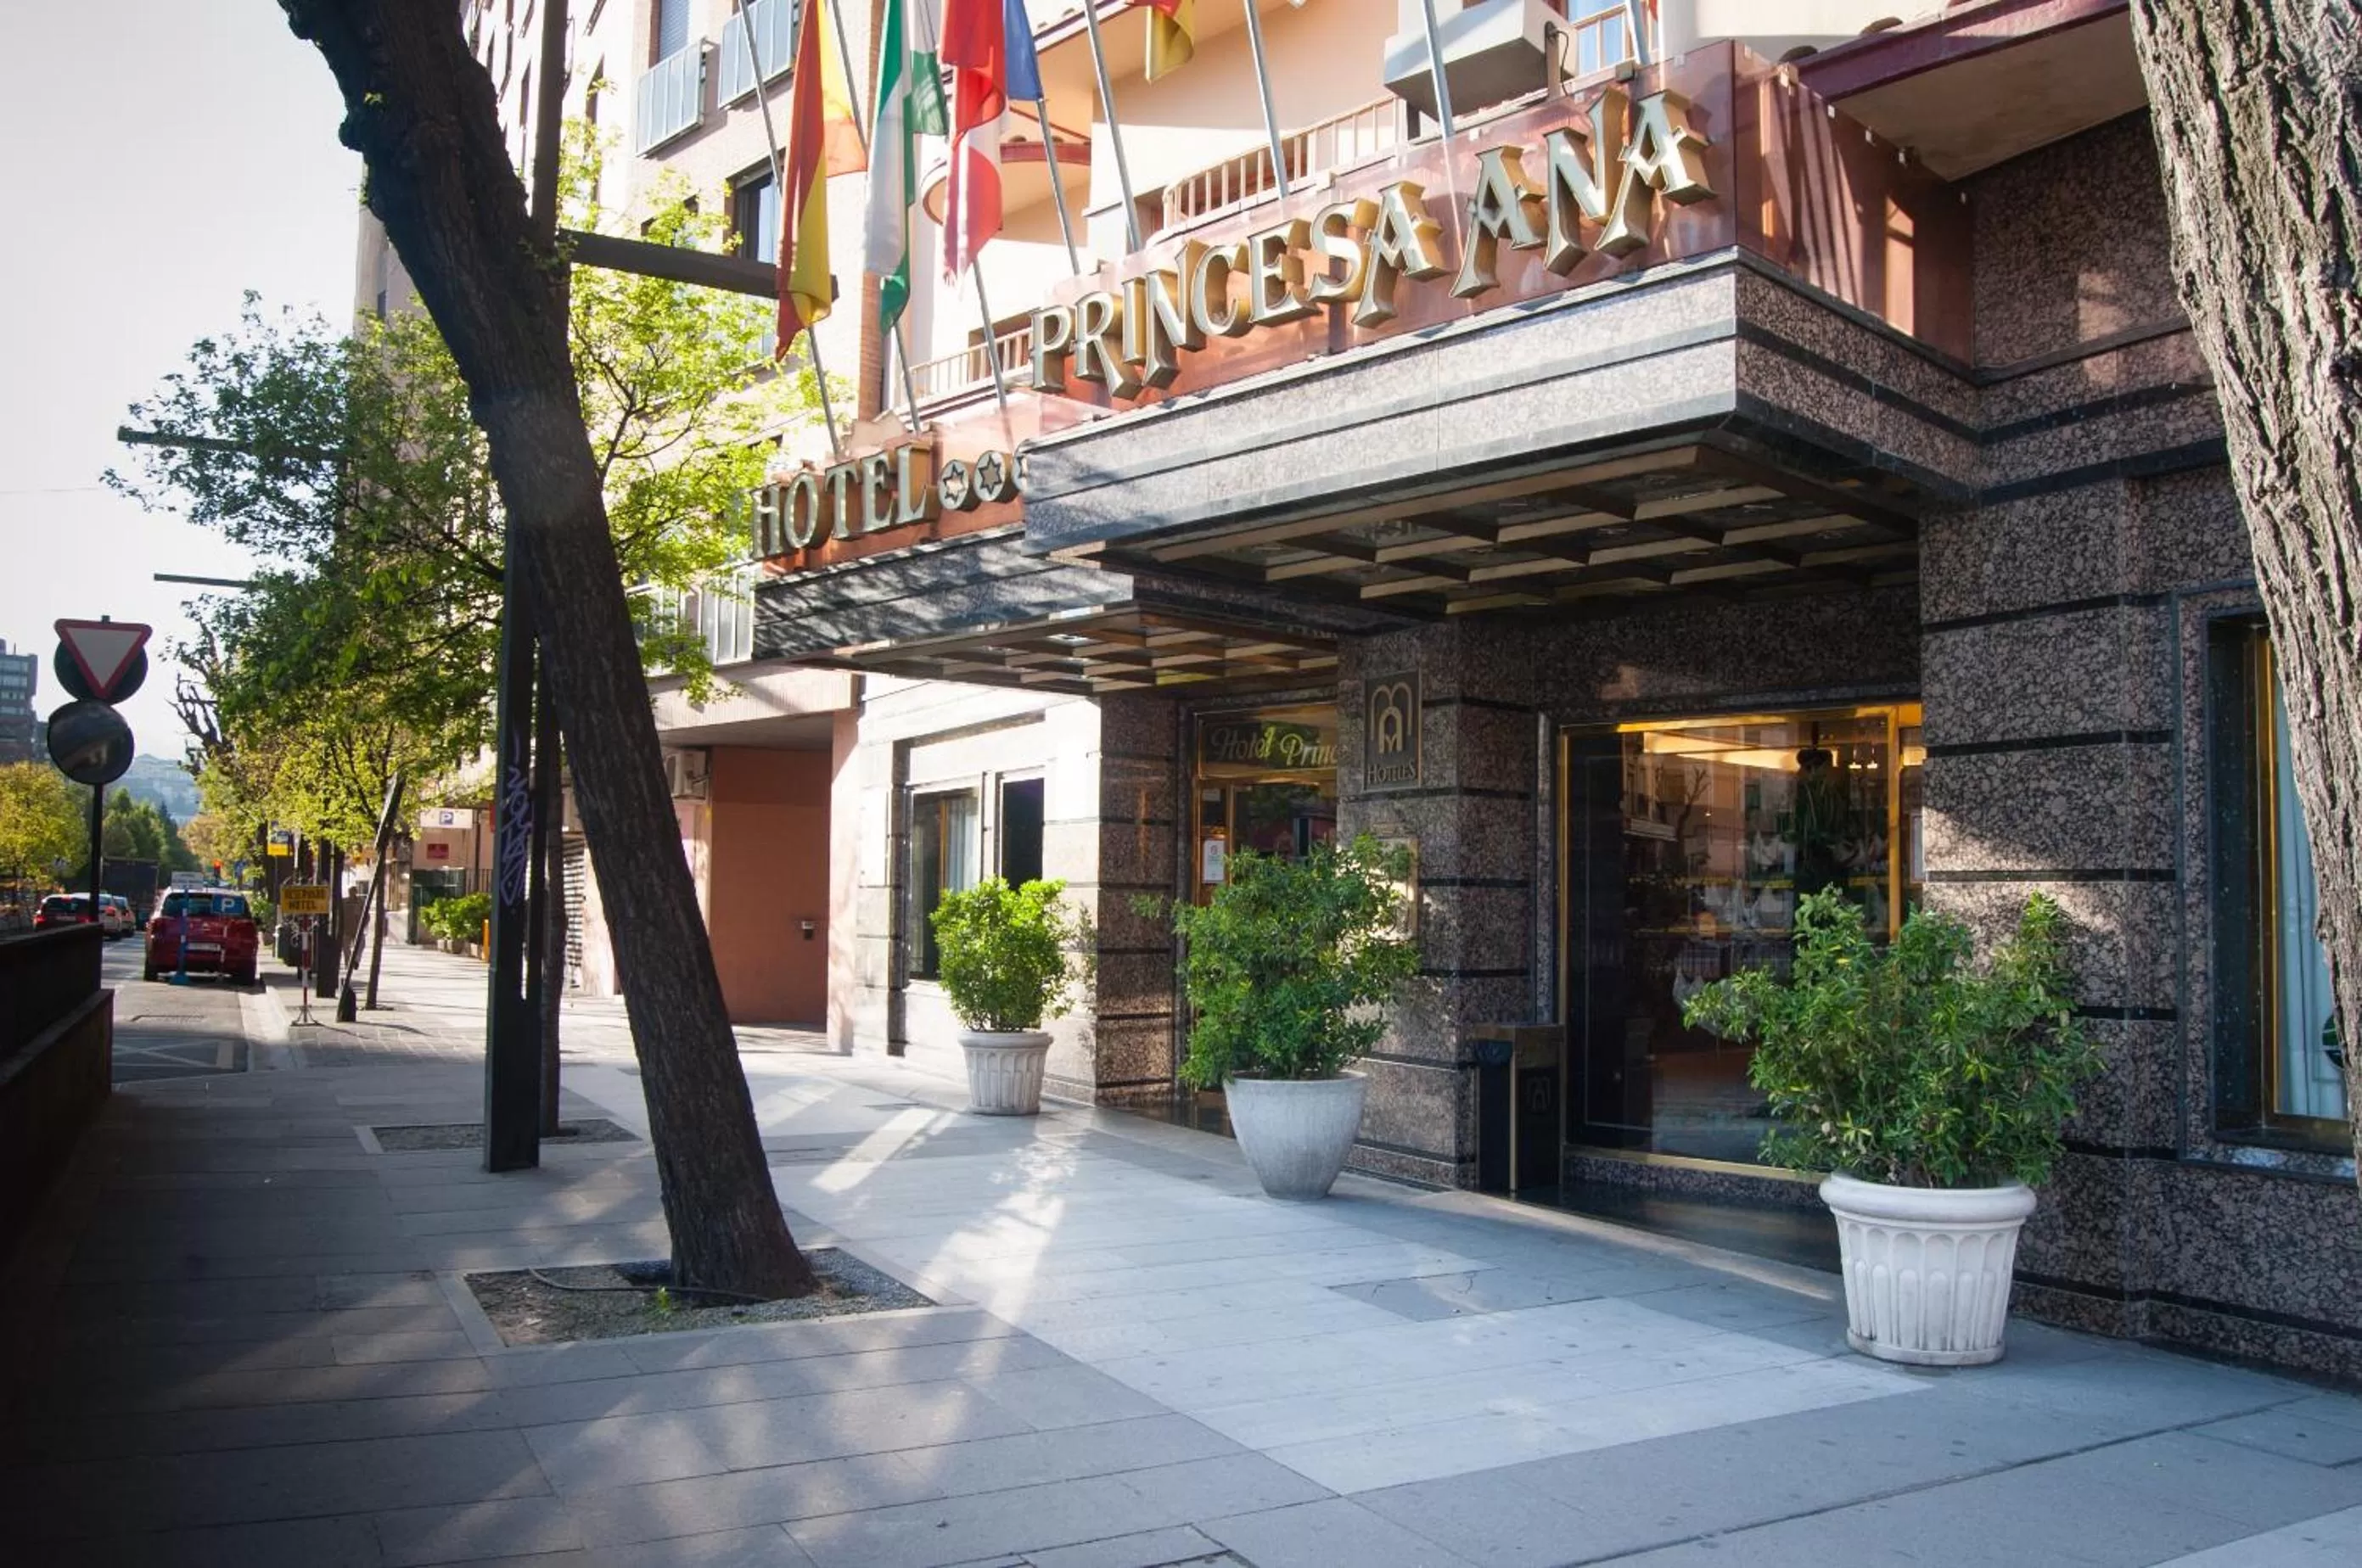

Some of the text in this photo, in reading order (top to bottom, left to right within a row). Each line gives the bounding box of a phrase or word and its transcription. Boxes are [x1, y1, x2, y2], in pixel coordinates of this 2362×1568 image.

[1029, 87, 1720, 399] PRINCESA ANA
[751, 440, 939, 560] HOTEL
[1211, 725, 1276, 760] Hotel
[441, 813, 453, 825] P
[222, 898, 235, 912] P
